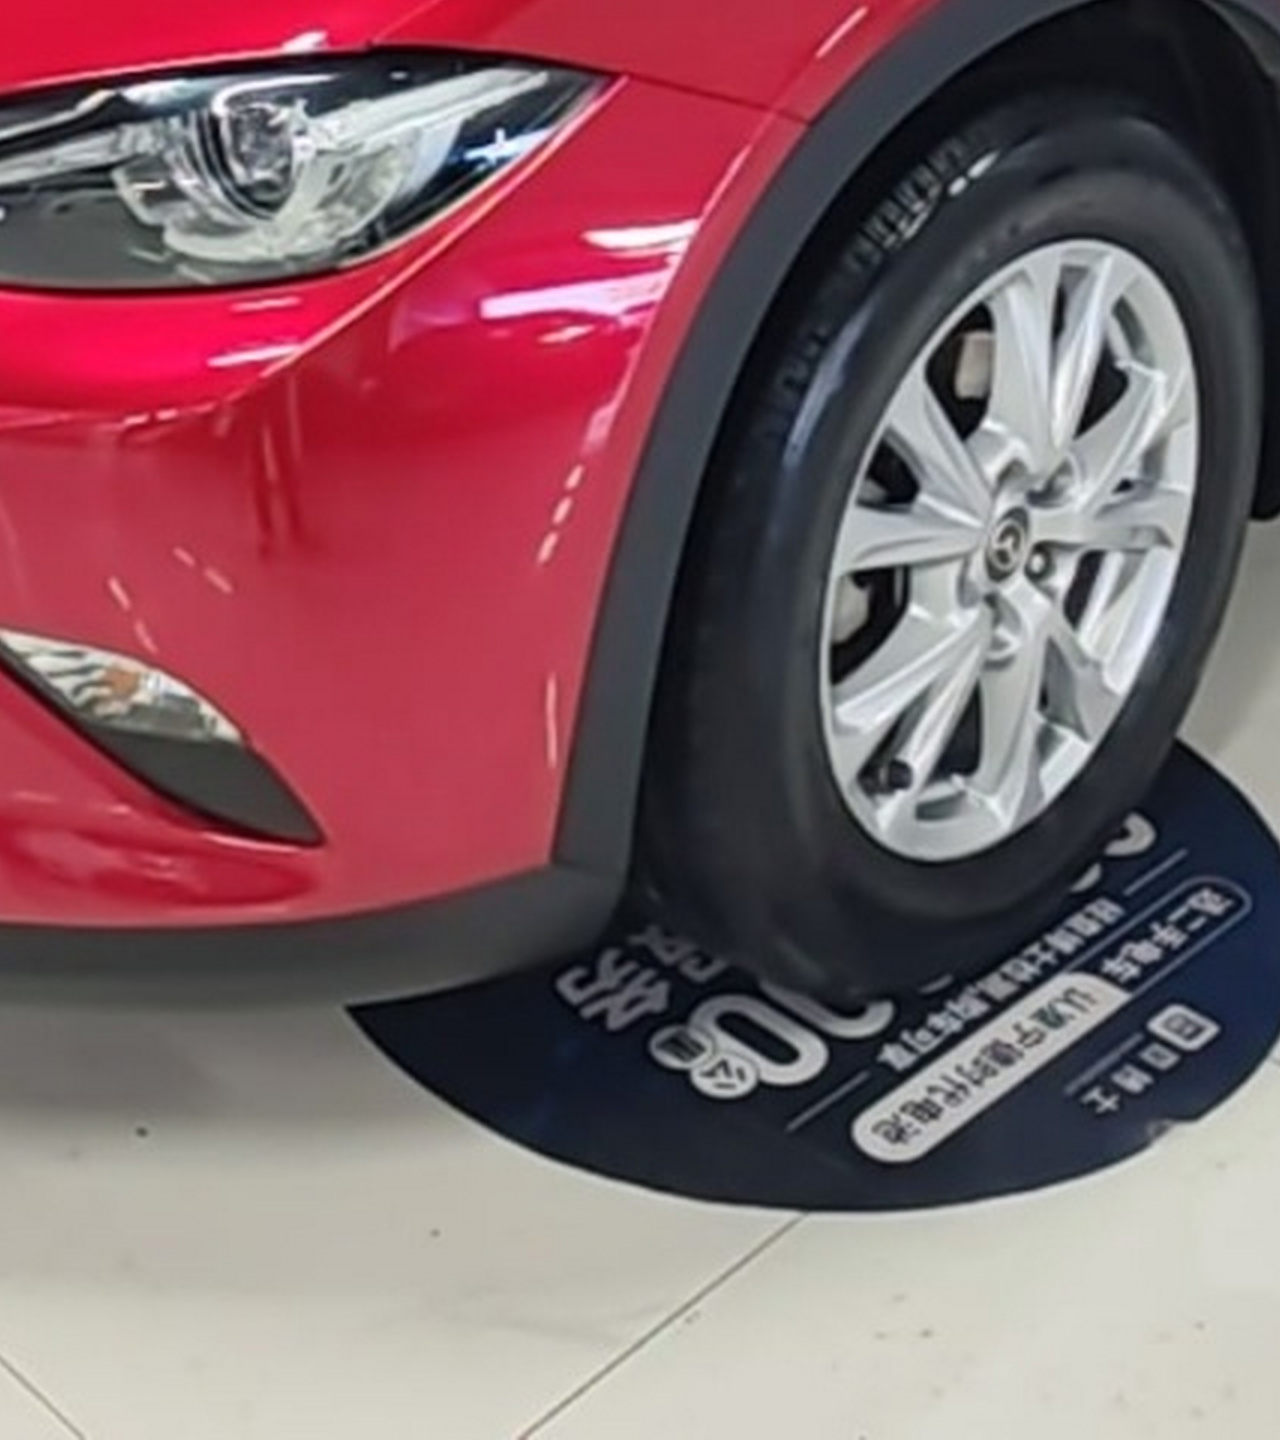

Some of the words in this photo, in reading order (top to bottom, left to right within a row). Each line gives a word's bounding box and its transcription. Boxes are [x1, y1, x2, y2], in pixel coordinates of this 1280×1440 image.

[869, 985, 1100, 1147] 认准宁德时代电池
